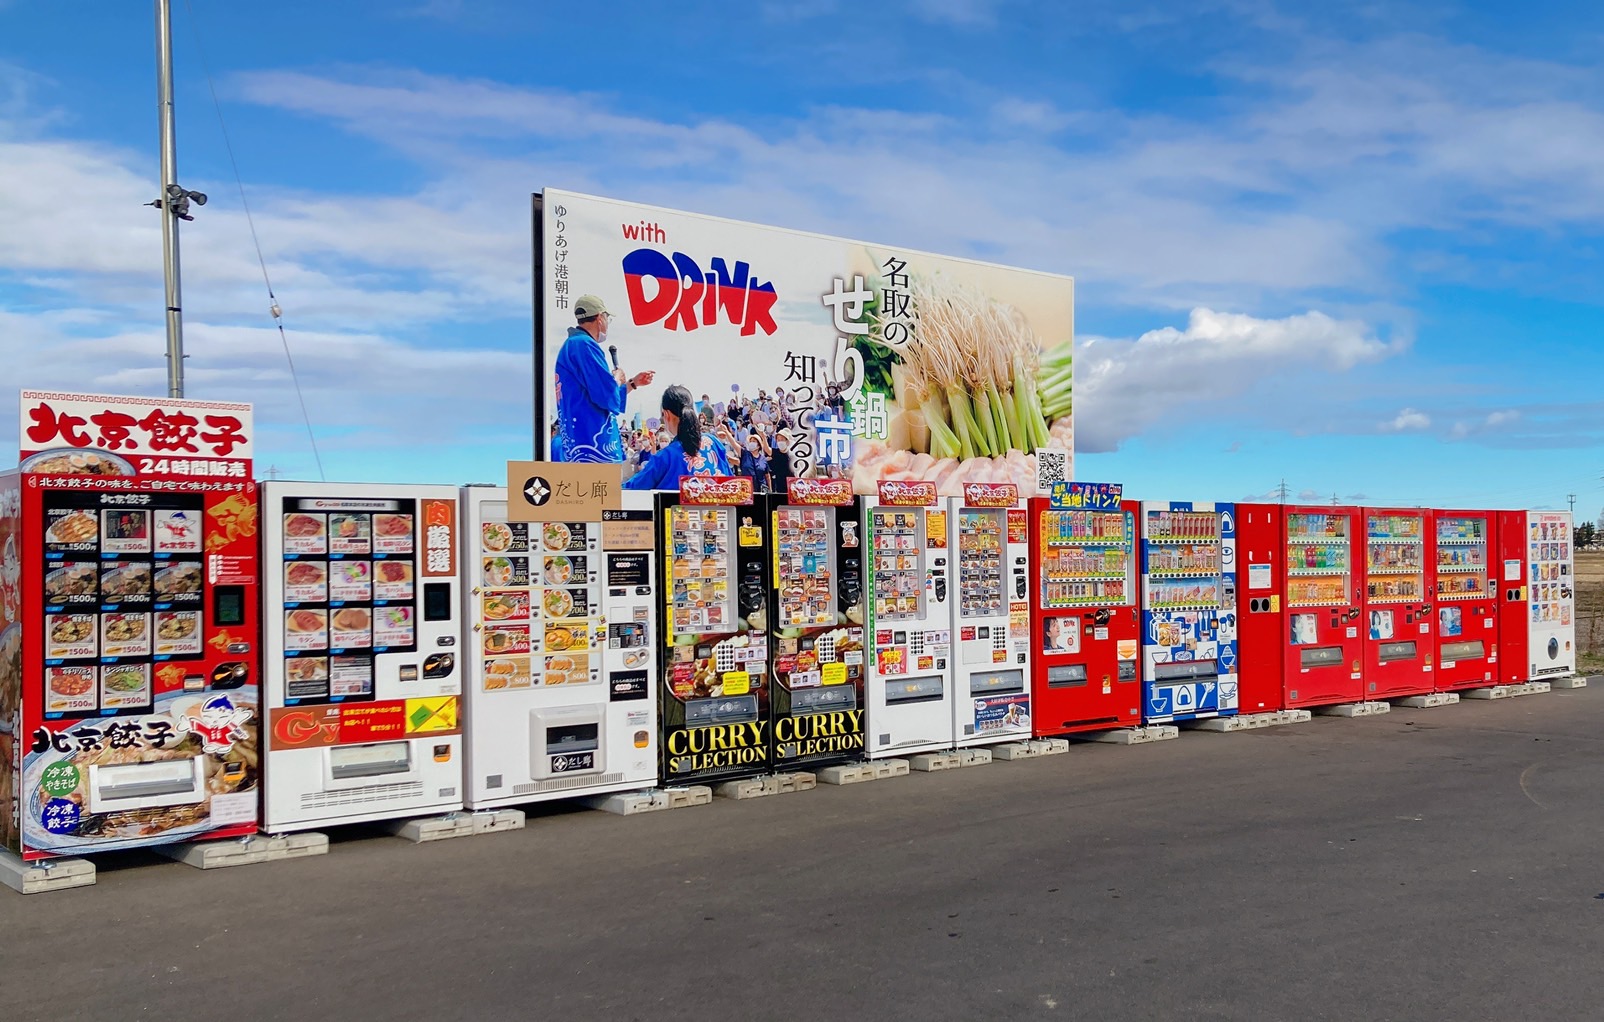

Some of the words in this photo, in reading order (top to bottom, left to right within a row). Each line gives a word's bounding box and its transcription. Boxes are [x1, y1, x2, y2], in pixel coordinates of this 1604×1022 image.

[622, 221, 666, 244] with
[554, 204, 569, 310] ゆりあげ港朝市
[622, 248, 778, 336] DRINK
[882, 256, 911, 346] 名取の
[26, 402, 248, 456] 北京餃子
[139, 457, 247, 478] 24時間販売
[39, 477, 245, 492] 北京餃子の味を、ご自宅で味わえます
[555, 480, 608, 505] だし廊
[704, 483, 740, 494] 北京餃子
[809, 483, 841, 494] 北京餃子
[898, 486, 926, 497] 北京餃子
[982, 487, 1009, 497] 北京餃子
[100, 493, 152, 505] 北京餃子
[1051, 492, 1121, 508] ご当地ドリンク
[775, 709, 864, 742] CURRY
[31, 721, 176, 753] 北京餃子
[668, 720, 768, 756] CURRY
[46, 765, 75, 778] 冷凍
[45, 777, 77, 791] やきそば
[46, 803, 75, 817] 冷凍
[46, 816, 75, 830] 餃子
